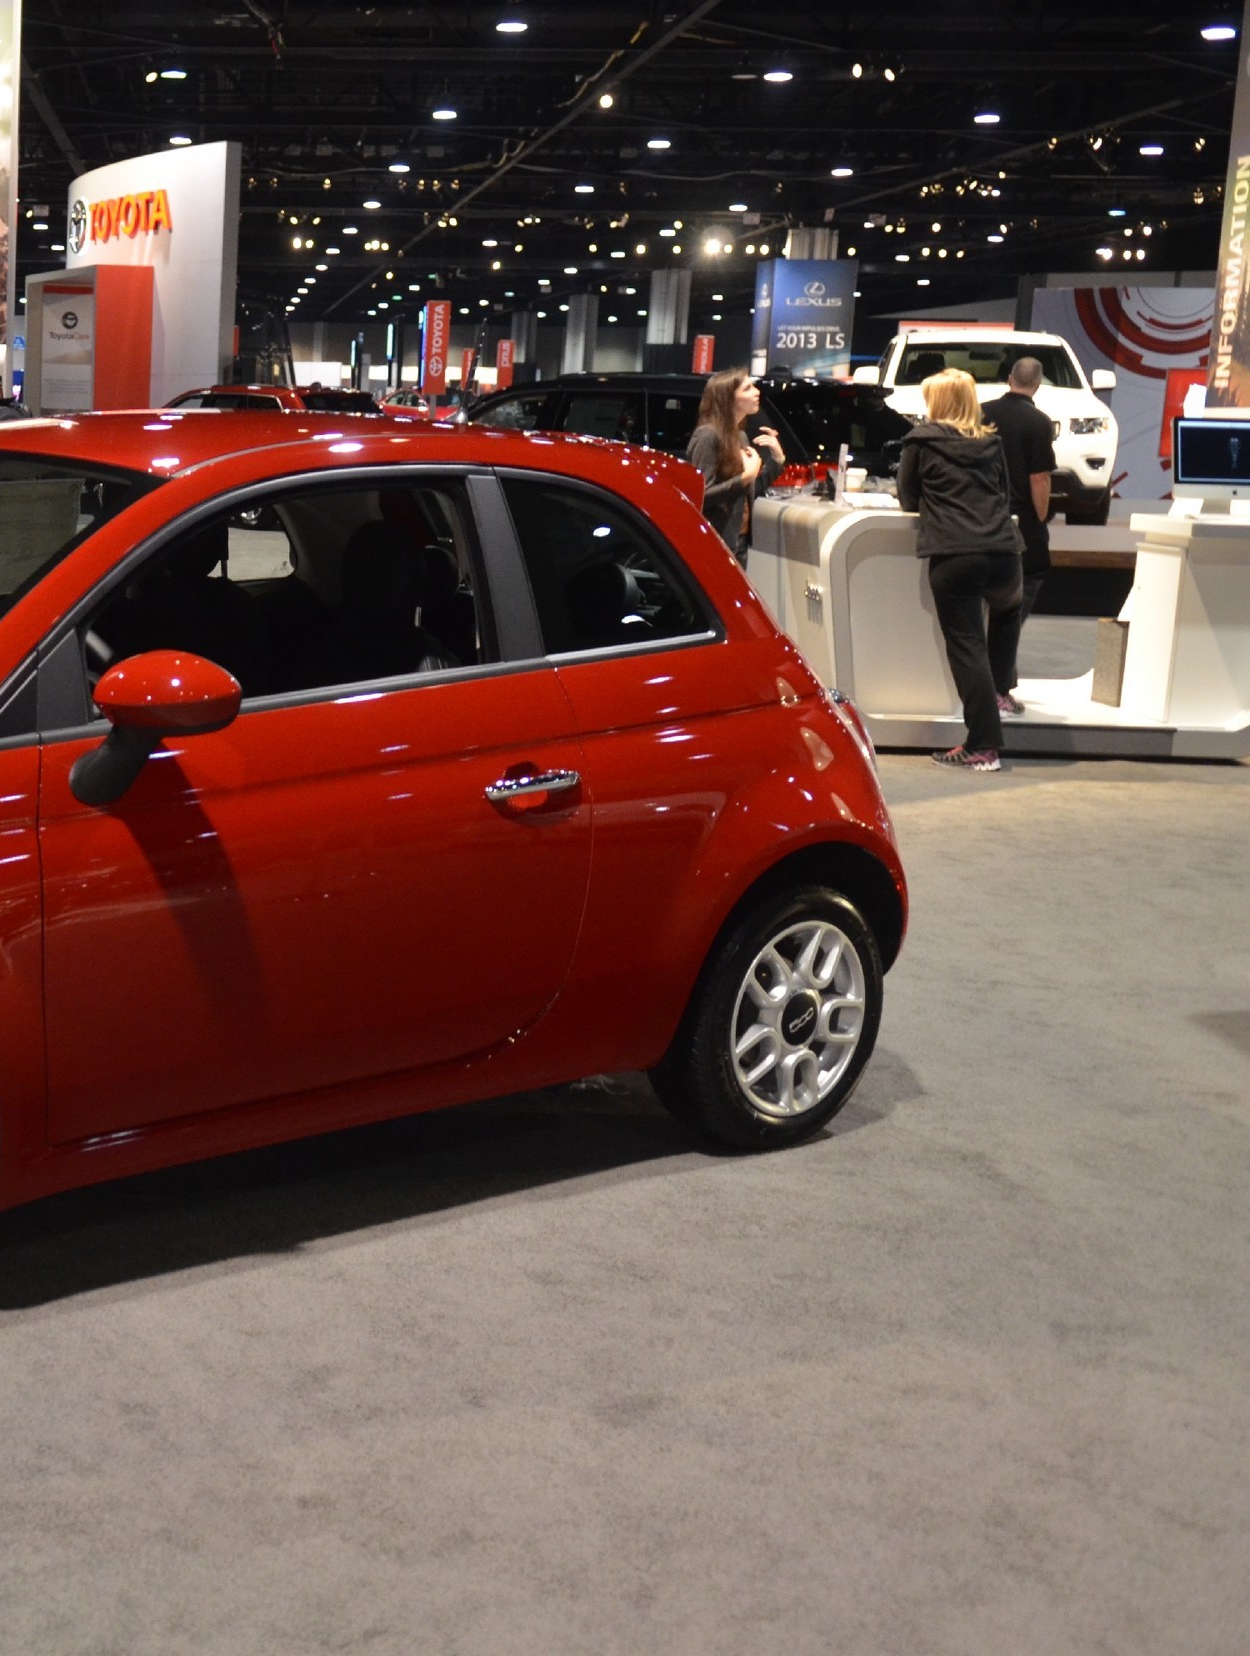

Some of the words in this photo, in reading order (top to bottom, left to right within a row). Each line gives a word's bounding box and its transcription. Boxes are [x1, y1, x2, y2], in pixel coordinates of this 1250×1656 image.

[89, 189, 172, 244] TOYOTA
[1213, 155, 1250, 389] INFORMATION
[786, 297, 842, 307] LEXUS
[432, 303, 445, 354] TOYOTA
[776, 332, 817, 349] 2013
[825, 332, 845, 349] LS
